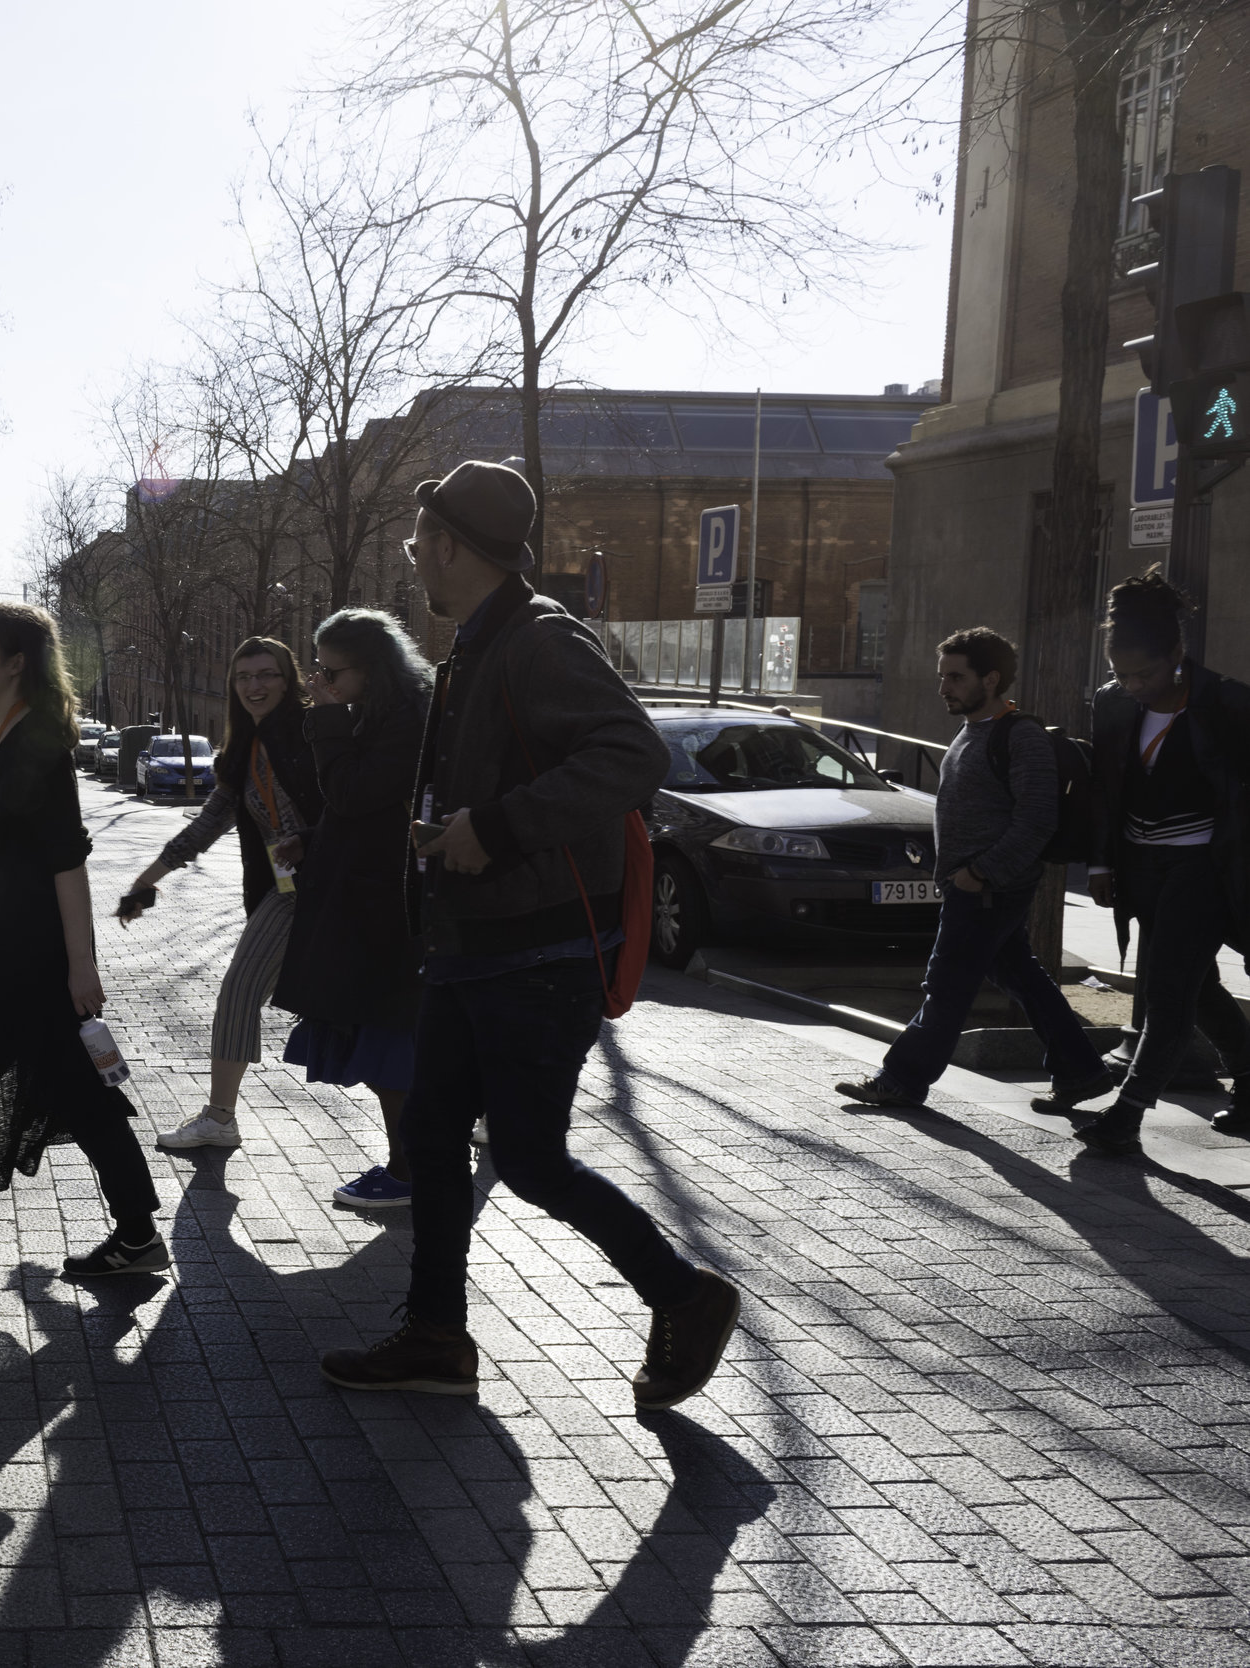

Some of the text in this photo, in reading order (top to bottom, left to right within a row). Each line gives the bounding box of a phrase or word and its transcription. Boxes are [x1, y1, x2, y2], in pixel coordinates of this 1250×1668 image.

[708, 517, 726, 576] P
[885, 883, 927, 900] 7919
[104, 1252, 130, 1268] N
